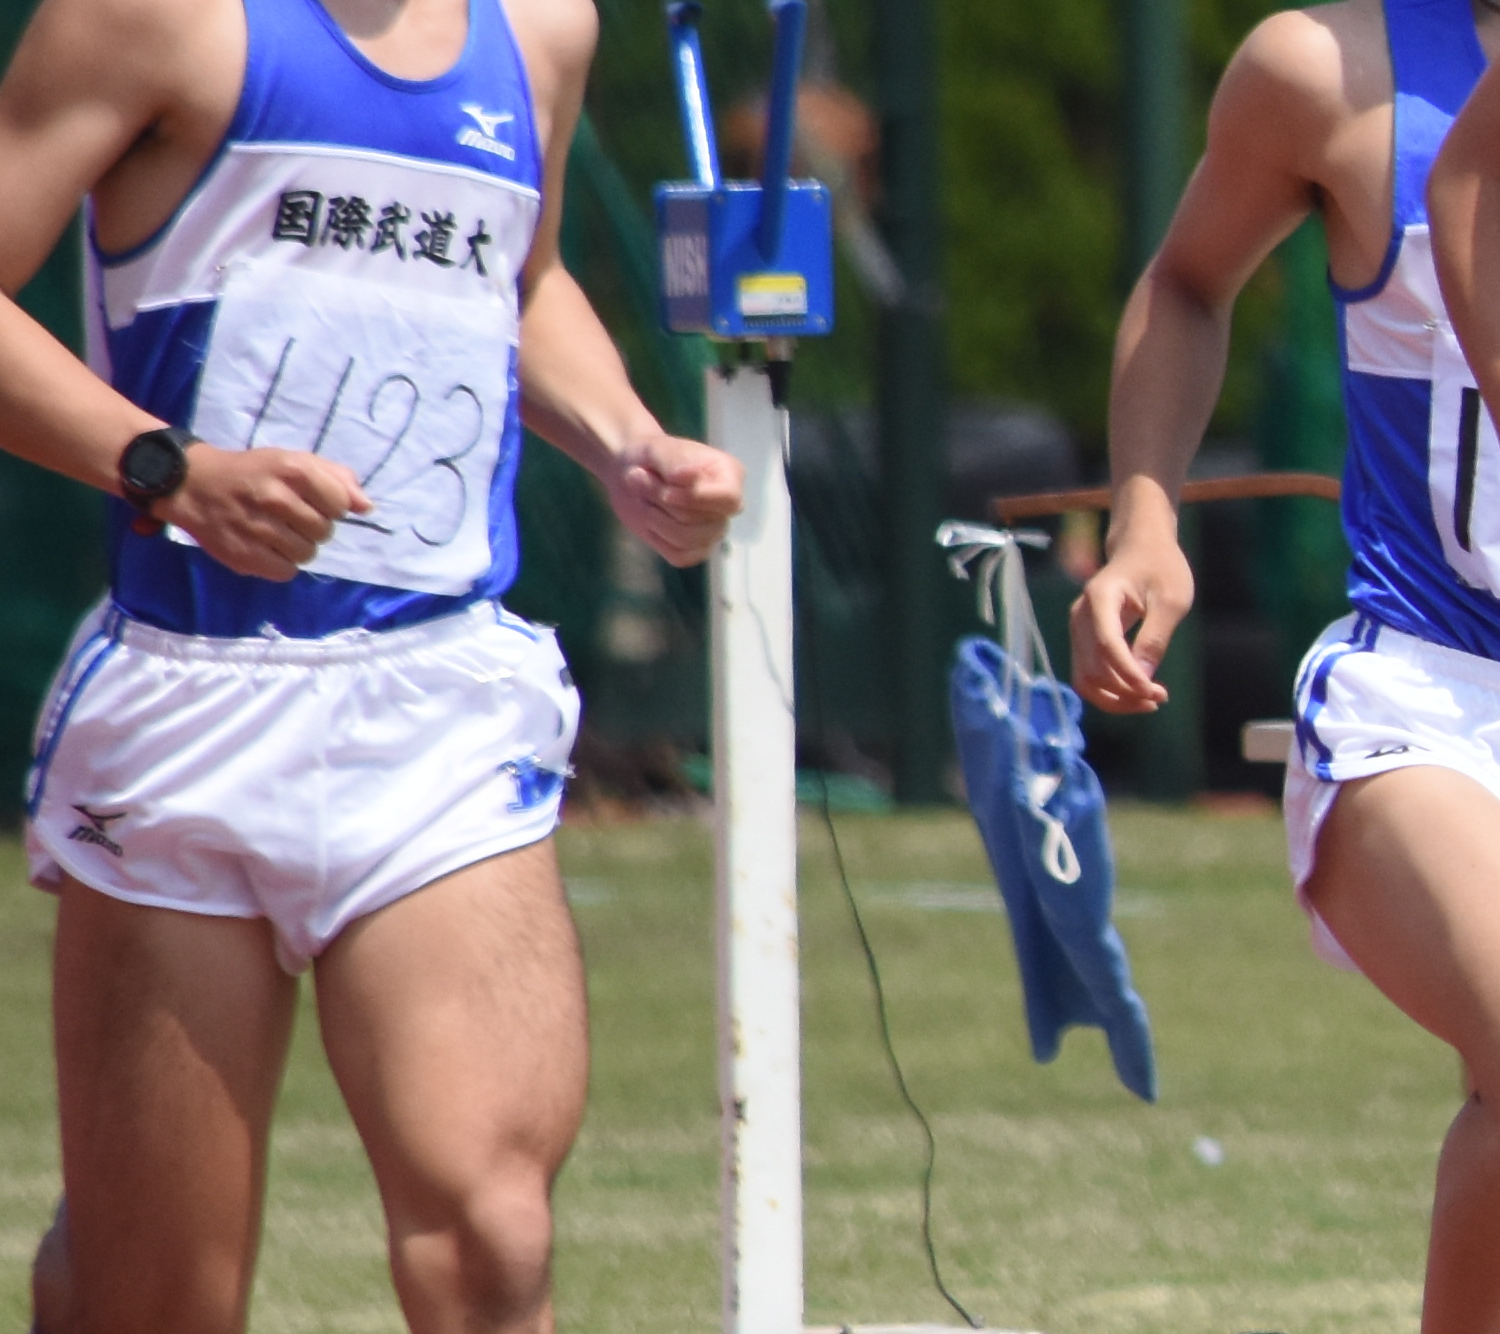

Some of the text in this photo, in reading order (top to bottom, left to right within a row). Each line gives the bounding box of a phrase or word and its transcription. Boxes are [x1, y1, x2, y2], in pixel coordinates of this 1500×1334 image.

[273, 190, 492, 277] 国際武道大
